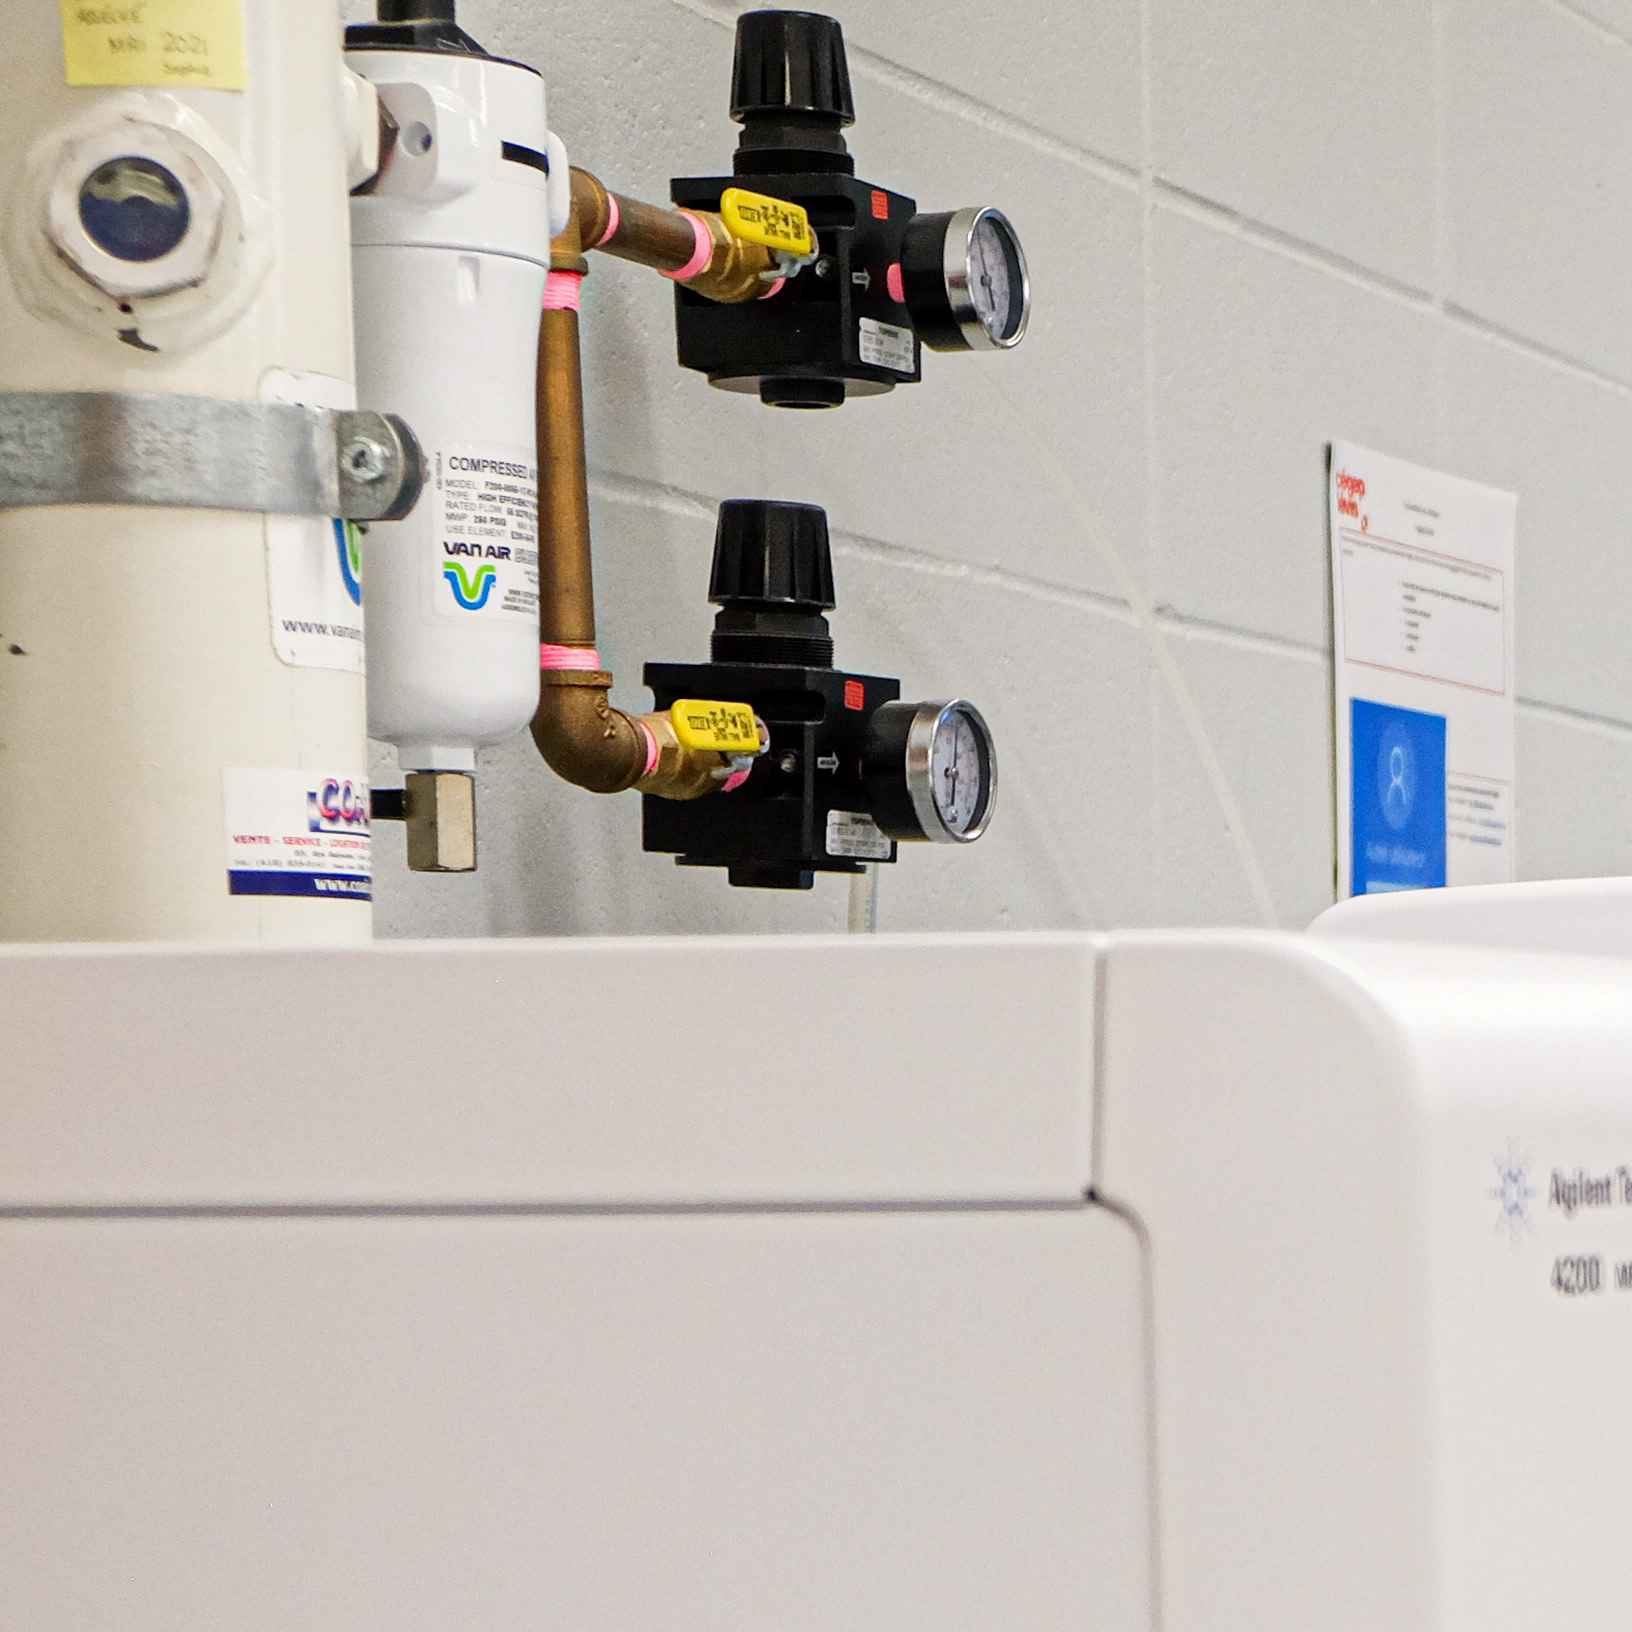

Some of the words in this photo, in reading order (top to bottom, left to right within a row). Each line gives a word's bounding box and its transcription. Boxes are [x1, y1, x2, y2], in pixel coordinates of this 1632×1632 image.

[485, 545, 511, 561] AIR
[1551, 1169, 1611, 1219] Agilent
[1552, 1255, 1601, 1295] 4200
